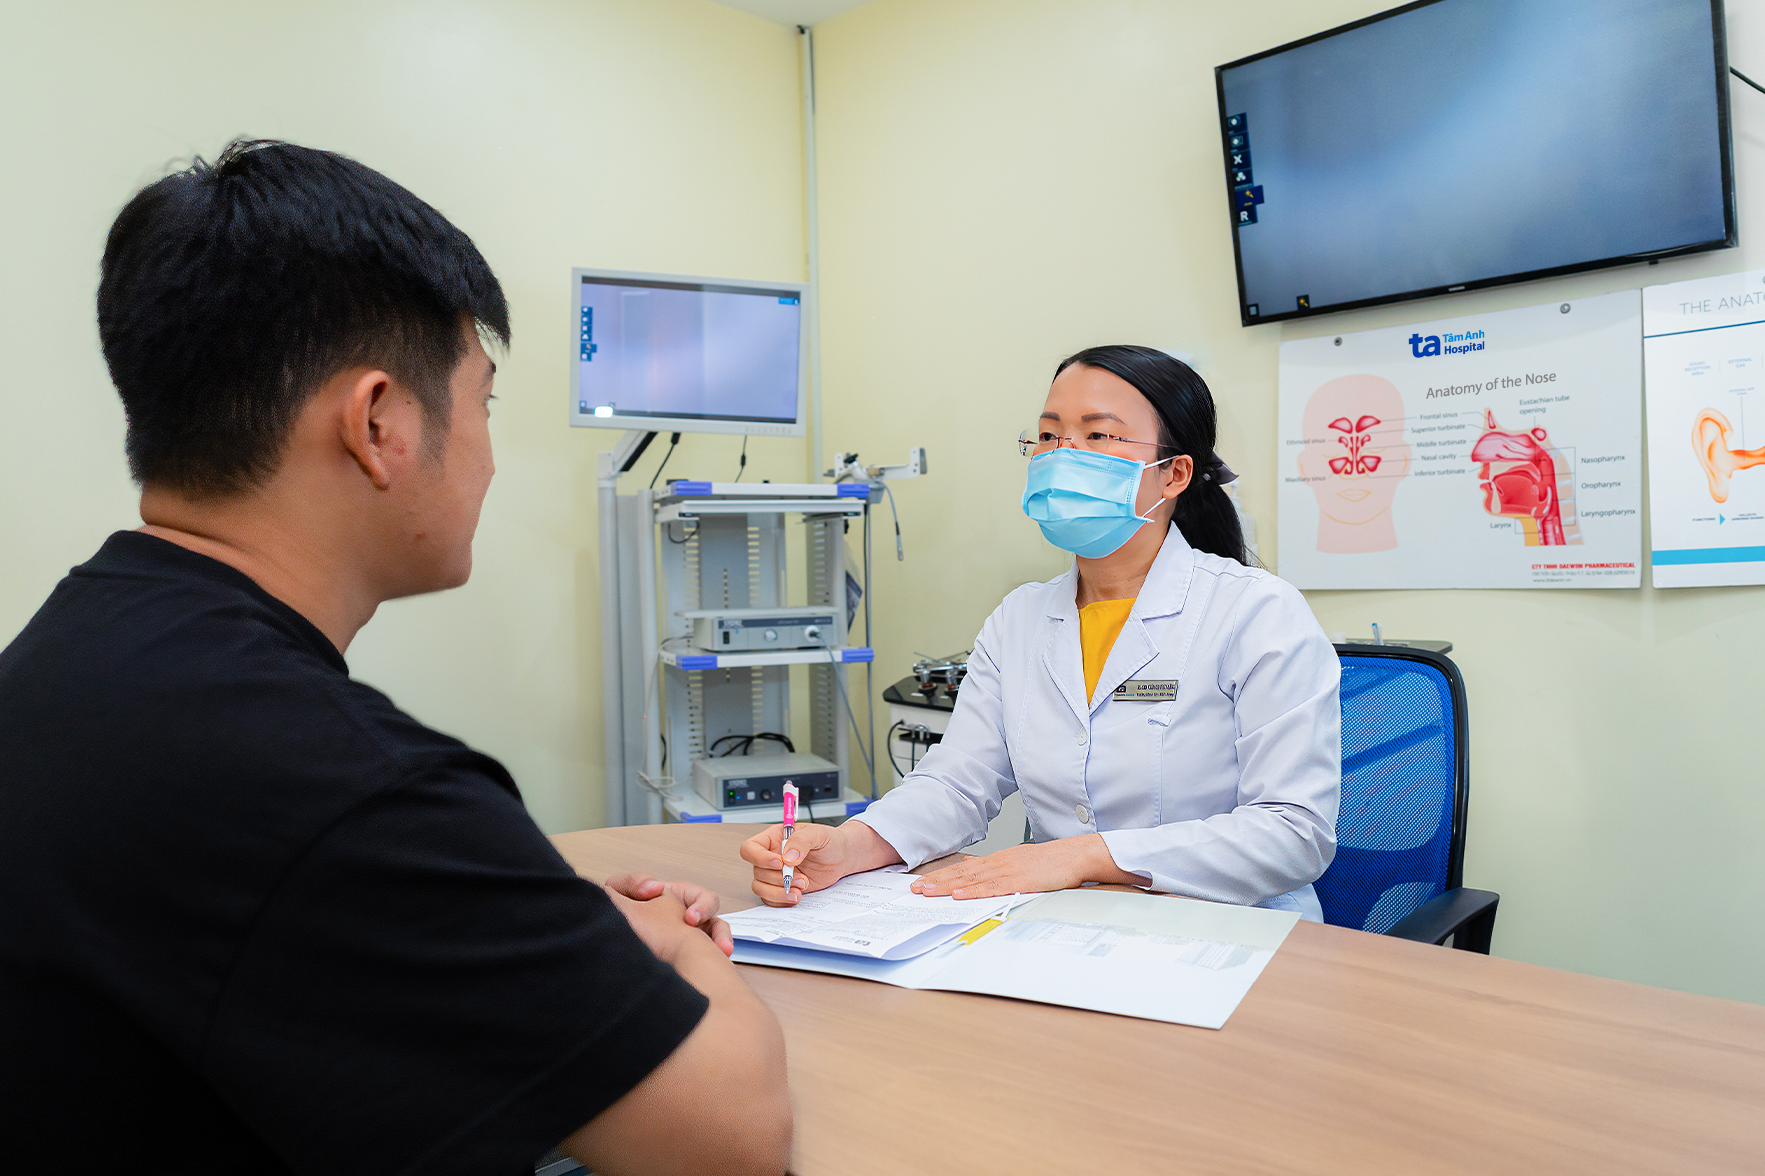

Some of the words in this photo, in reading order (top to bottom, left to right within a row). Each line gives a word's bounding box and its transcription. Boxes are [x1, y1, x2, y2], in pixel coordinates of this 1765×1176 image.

[1679, 299, 1712, 315] THE
[1442, 333, 1464, 343] Tâm
[1464, 329, 1485, 341] Anh
[1408, 333, 1441, 358] ta
[1444, 341, 1485, 355] Hospital
[1728, 357, 1753, 365] EXTERNAL
[1426, 382, 1482, 399] Anatomy
[1485, 377, 1499, 391] of
[1501, 376, 1522, 388] the
[1525, 372, 1557, 386] Nose
[1519, 396, 1554, 406] Eustachian
[1554, 394, 1571, 402] tube
[1519, 406, 1547, 415] opening
[1420, 412, 1442, 420] Frontal
[1411, 426, 1435, 434] Superior
[1436, 423, 1466, 432] turbinate
[1416, 440, 1438, 448] Middle
[1438, 438, 1467, 446] turbinate
[1438, 453, 1457, 461] cavity
[1581, 454, 1626, 465] Nasopharynx
[1437, 467, 1466, 476] turbinate
[1581, 481, 1621, 490] Oropharynx
[1581, 509, 1636, 518] Laryngopharynx
[1490, 522, 1512, 530] Larynx
